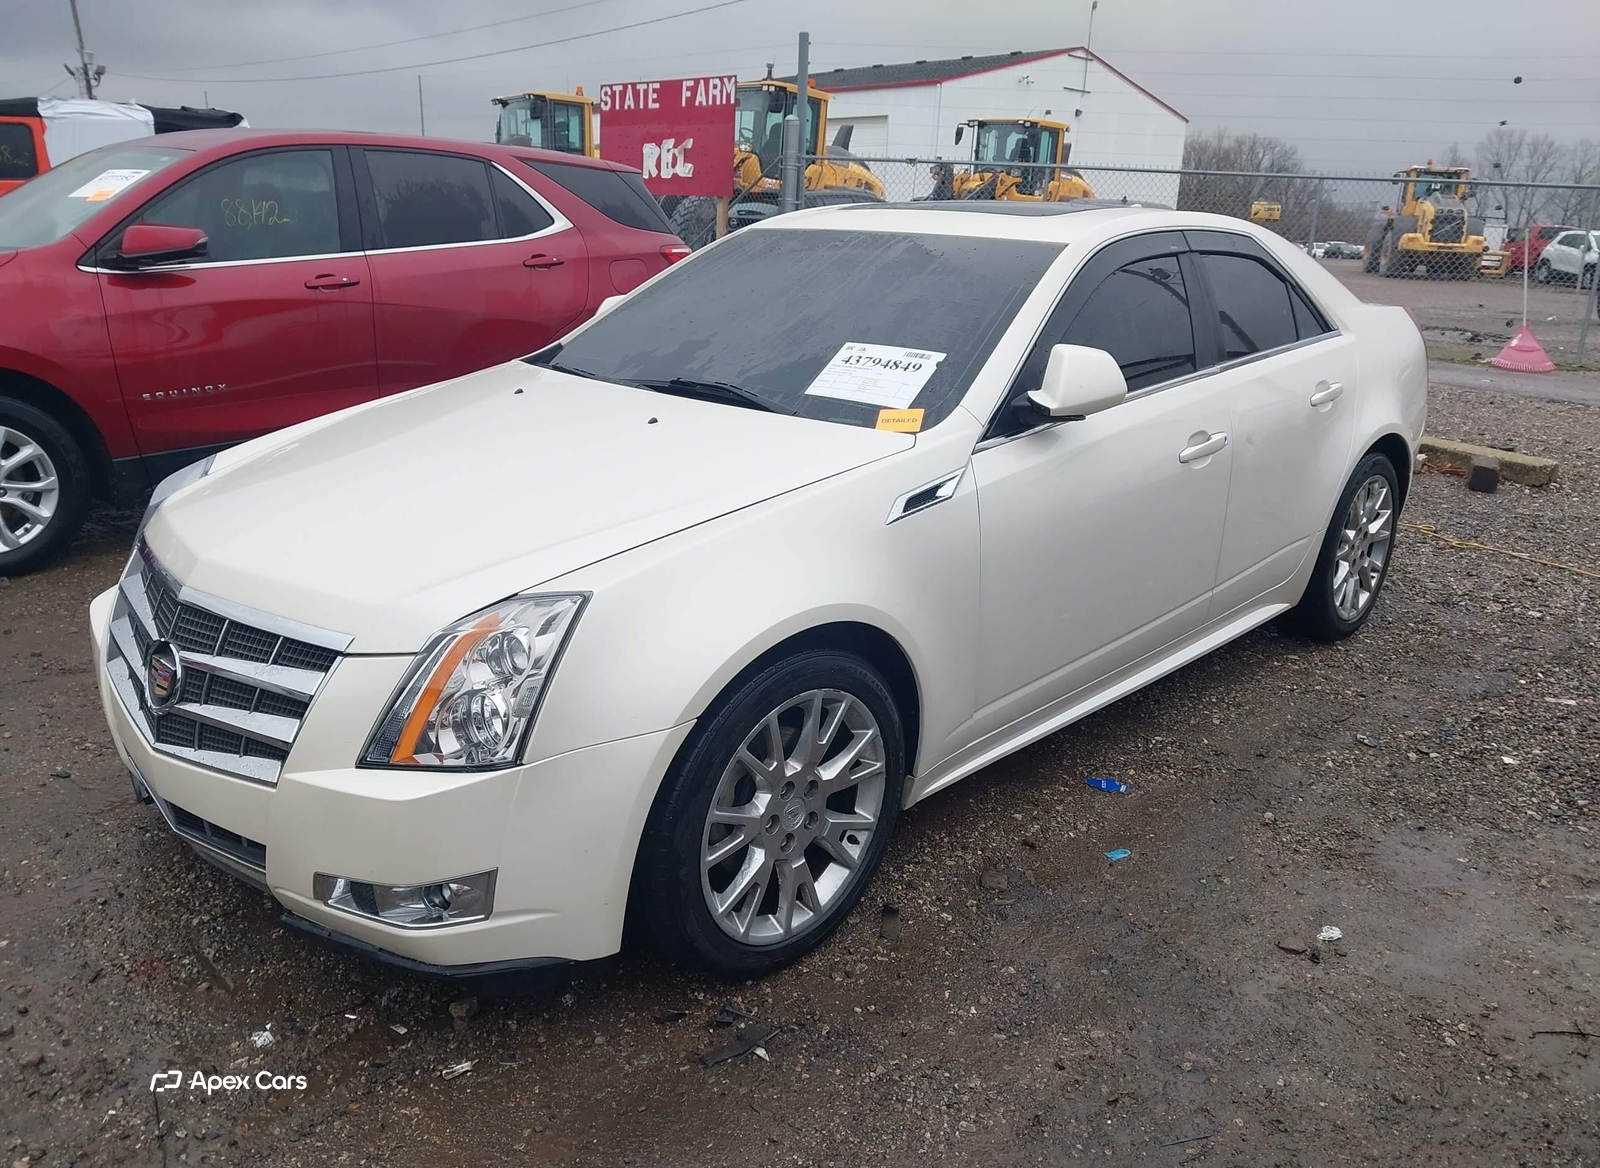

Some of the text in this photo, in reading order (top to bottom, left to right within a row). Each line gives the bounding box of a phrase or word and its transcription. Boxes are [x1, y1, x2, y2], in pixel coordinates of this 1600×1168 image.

[600, 77, 736, 111] STATE FARM
[841, 354, 923, 373] 43794849
[142, 383, 226, 401] EQUINOX
